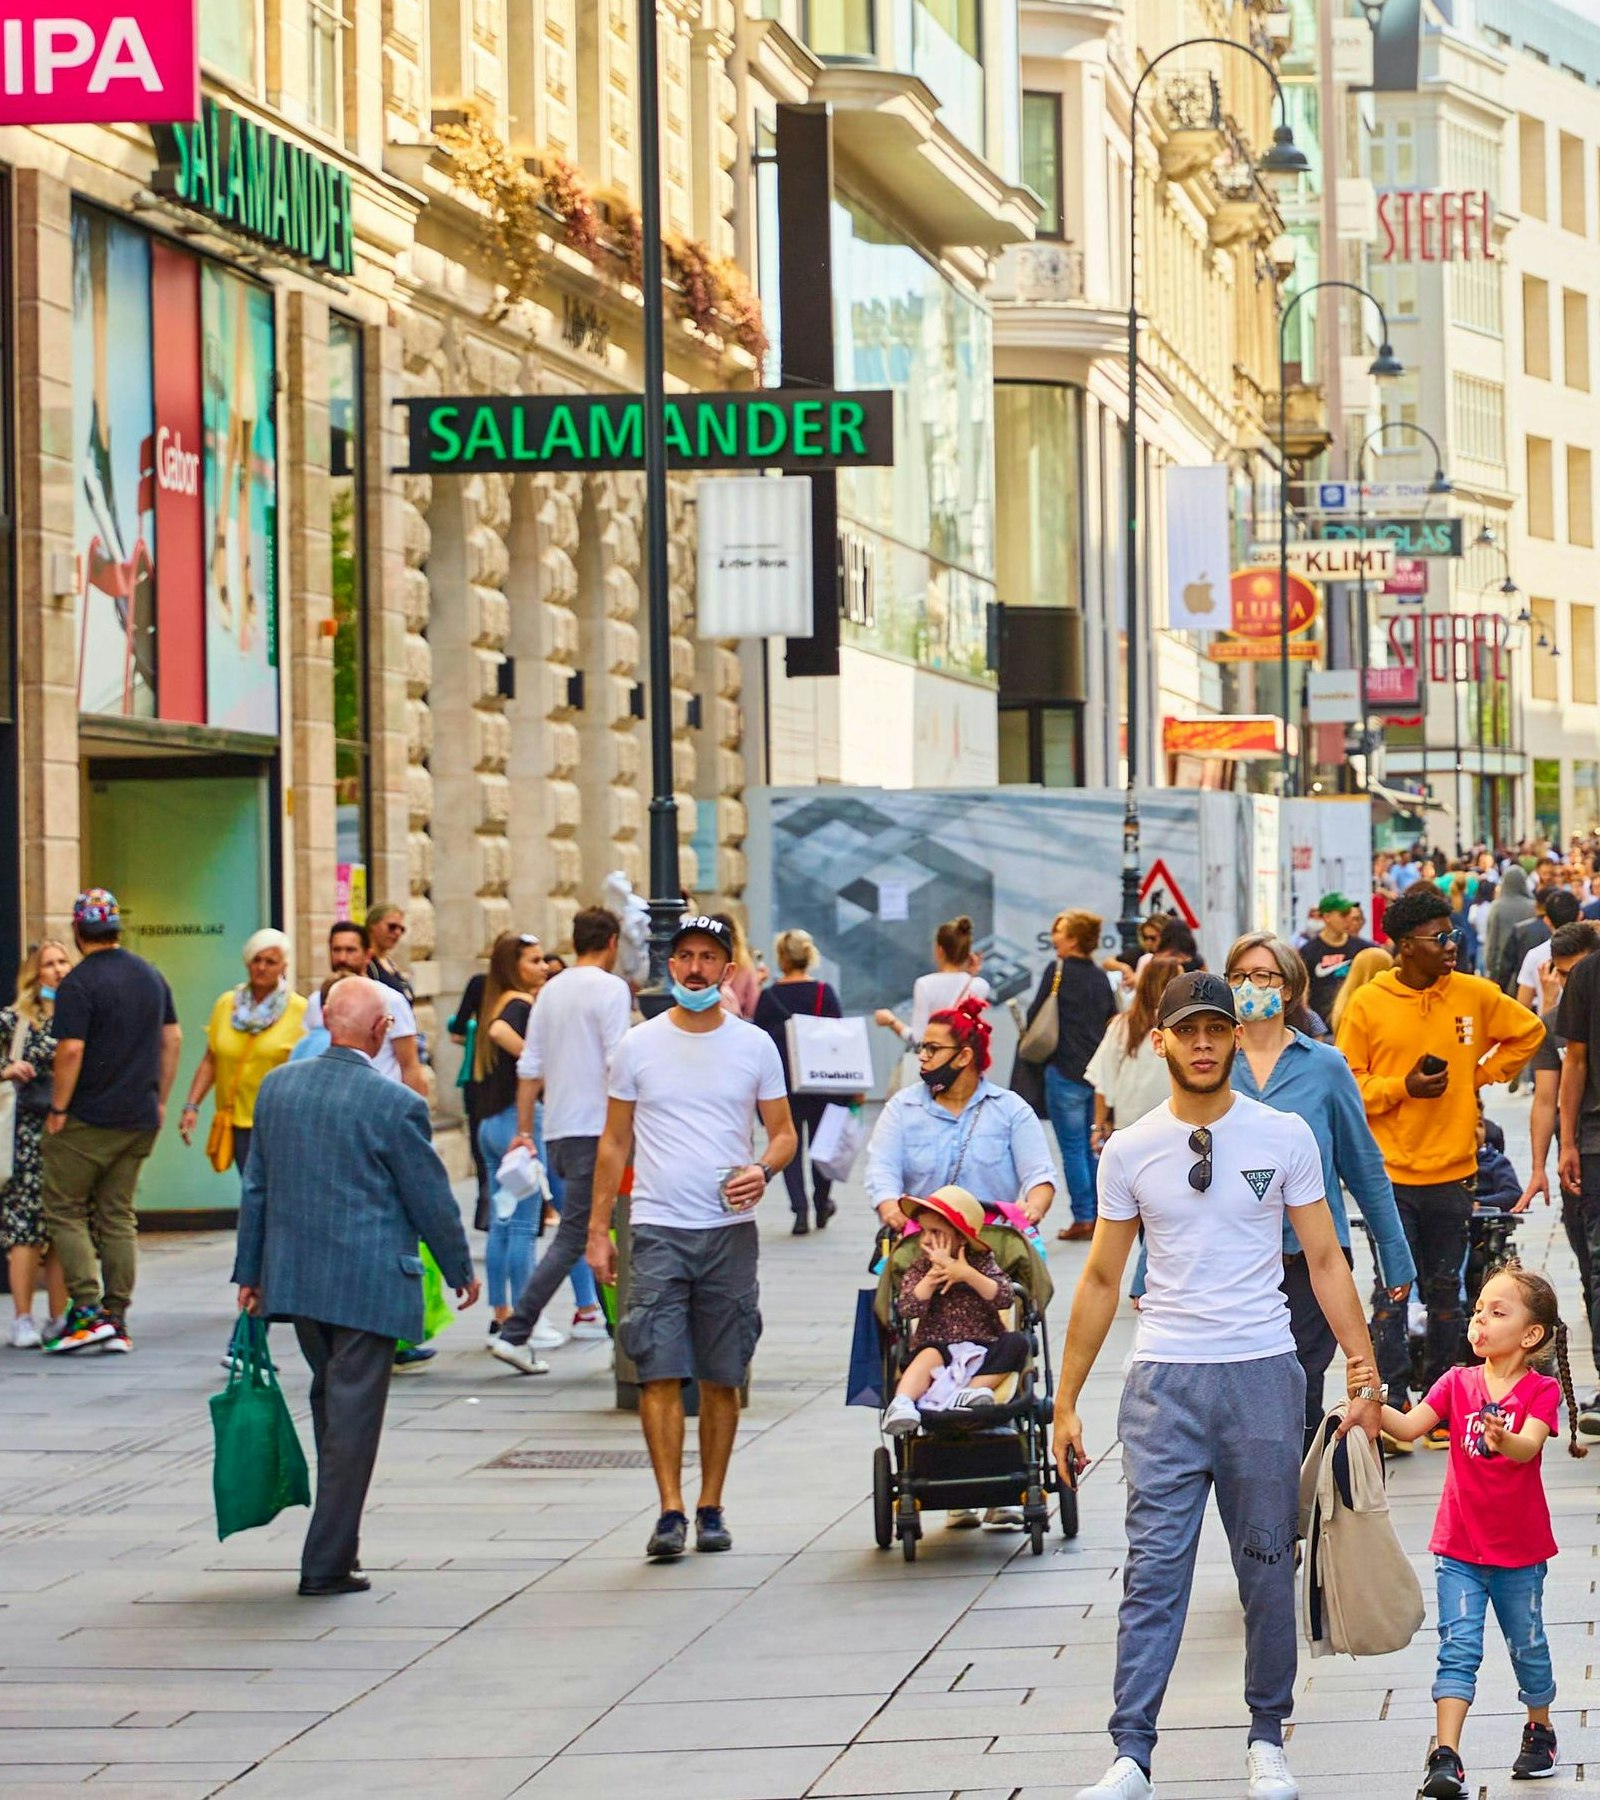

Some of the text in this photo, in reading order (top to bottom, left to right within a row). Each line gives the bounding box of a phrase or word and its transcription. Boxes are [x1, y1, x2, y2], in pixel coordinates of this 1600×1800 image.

[1377, 190, 1495, 264] STEFFL
[156, 426, 199, 496] Gabor
[428, 400, 867, 462] SALAMANDER
[1306, 550, 1392, 572] KLIMT
[1246, 1171, 1272, 1181] GUESS
